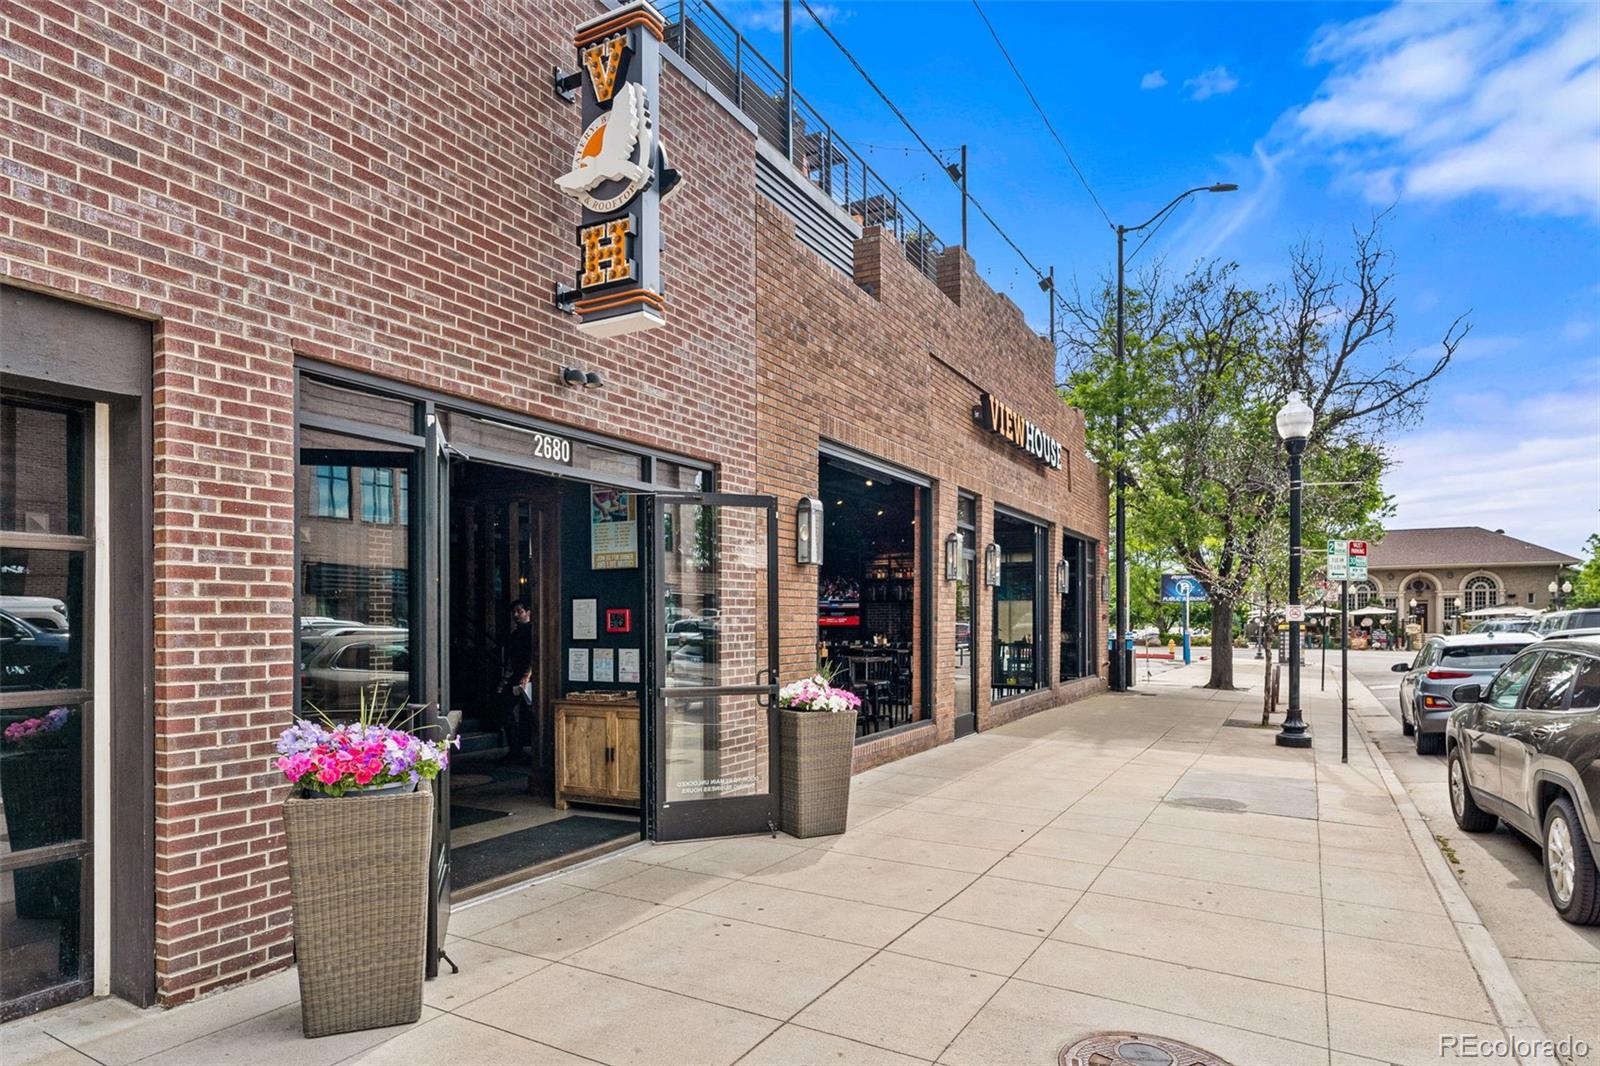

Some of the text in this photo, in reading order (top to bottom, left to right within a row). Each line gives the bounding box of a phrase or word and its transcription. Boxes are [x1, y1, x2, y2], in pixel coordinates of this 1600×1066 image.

[582, 34, 630, 103] V
[592, 184, 635, 210] ROOFTOP
[581, 216, 630, 289] H
[534, 434, 570, 462] 2680
[1329, 542, 1334, 553] 2
